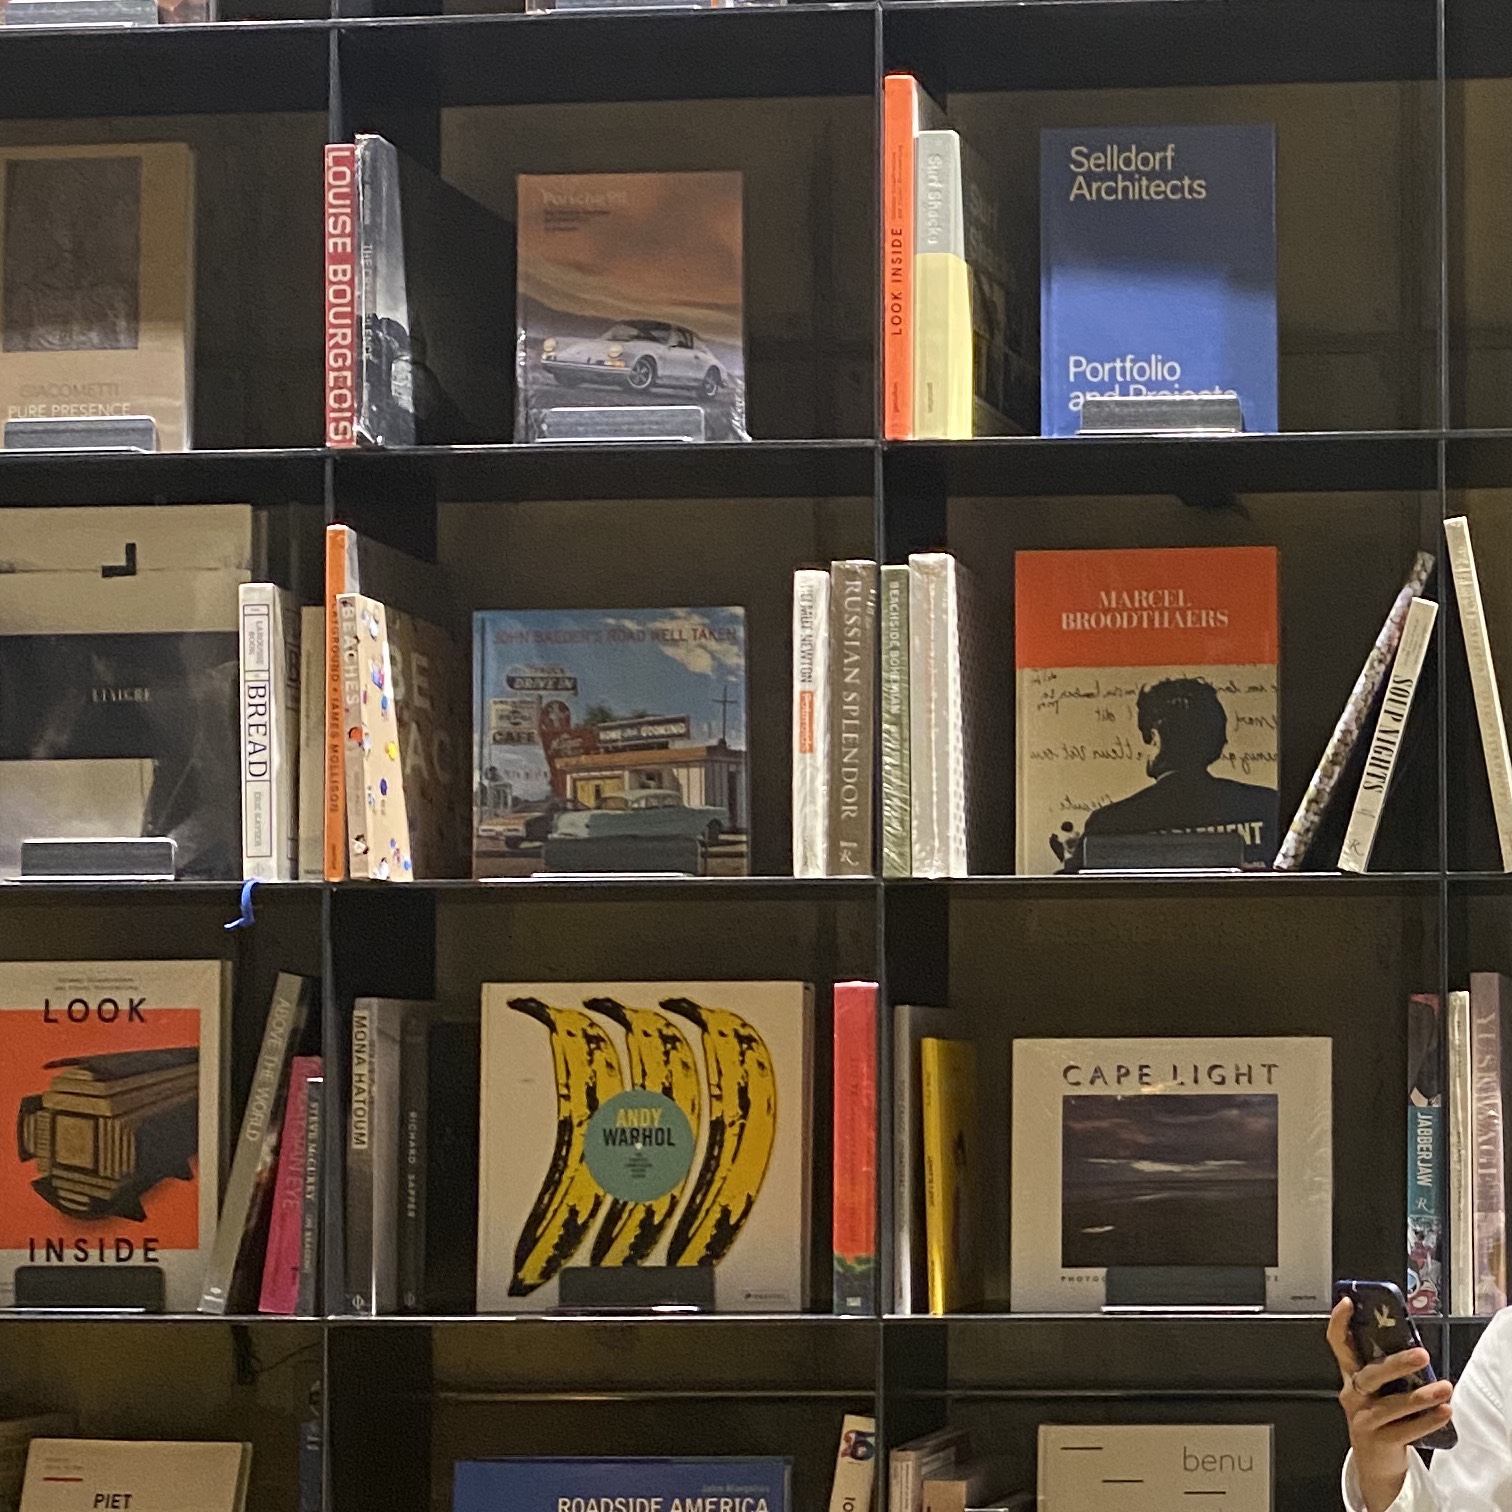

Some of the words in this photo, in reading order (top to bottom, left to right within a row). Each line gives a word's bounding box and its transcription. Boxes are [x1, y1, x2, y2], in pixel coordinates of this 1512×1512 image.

[927, 155, 943, 188] Surf
[1070, 144, 1175, 172] Selldorf
[328, 151, 351, 253] LOUISE
[1070, 174, 1206, 201] Architects
[891, 228, 902, 276] INSIDE
[891, 293, 902, 336] LOOK
[328, 263, 352, 441] BOURGEOIS
[1069, 354, 1181, 382] Portfolio
[8, 404, 47, 418] PURE
[51, 402, 131, 417] PRESENCE
[889, 581, 901, 646] BEACHSIDE
[1061, 608, 1229, 630] BROODTHAERS
[1100, 589, 1192, 609] MARCEL
[608, 628, 646, 644] ROAD
[650, 628, 686, 642] WELL
[692, 627, 737, 642] TAKEN
[843, 580, 862, 683] RUSSIAN
[341, 605, 359, 706] BEACHES
[801, 633, 813, 683] NEWTON
[889, 650, 901, 714] BOHEMIAN
[1384, 675, 1414, 722] SOUP
[247, 684, 268, 778] BREAD
[492, 731, 536, 744] CAFE
[329, 744, 340, 813] MOLLISON
[841, 691, 860, 820] SPLENDOR
[1363, 724, 1400, 793] NIGHTS
[43, 998, 148, 1023] LOOK
[267, 998, 290, 1047] ABOVE
[354, 1015, 368, 1066] MONA
[264, 1055, 279, 1083] THE
[1063, 1064, 1153, 1086] CAPE
[1174, 1063, 1280, 1085] LIGHT
[248, 1087, 271, 1142] WORLD
[307, 1102, 319, 1143] STEVE
[353, 1072, 368, 1147] HATOUM
[616, 1107, 662, 1127] ANDY
[407, 1111, 416, 1165] RICHARD
[603, 1127, 676, 1147] WARHOL
[1416, 1112, 1433, 1187] JABBERJAW
[306, 1145, 318, 1201] McCURRY
[407, 1174, 416, 1219] SAPPER
[29, 1237, 160, 1263] INSIDE
[1183, 1446, 1254, 1473] benu
[93, 1493, 133, 1509] PIET
